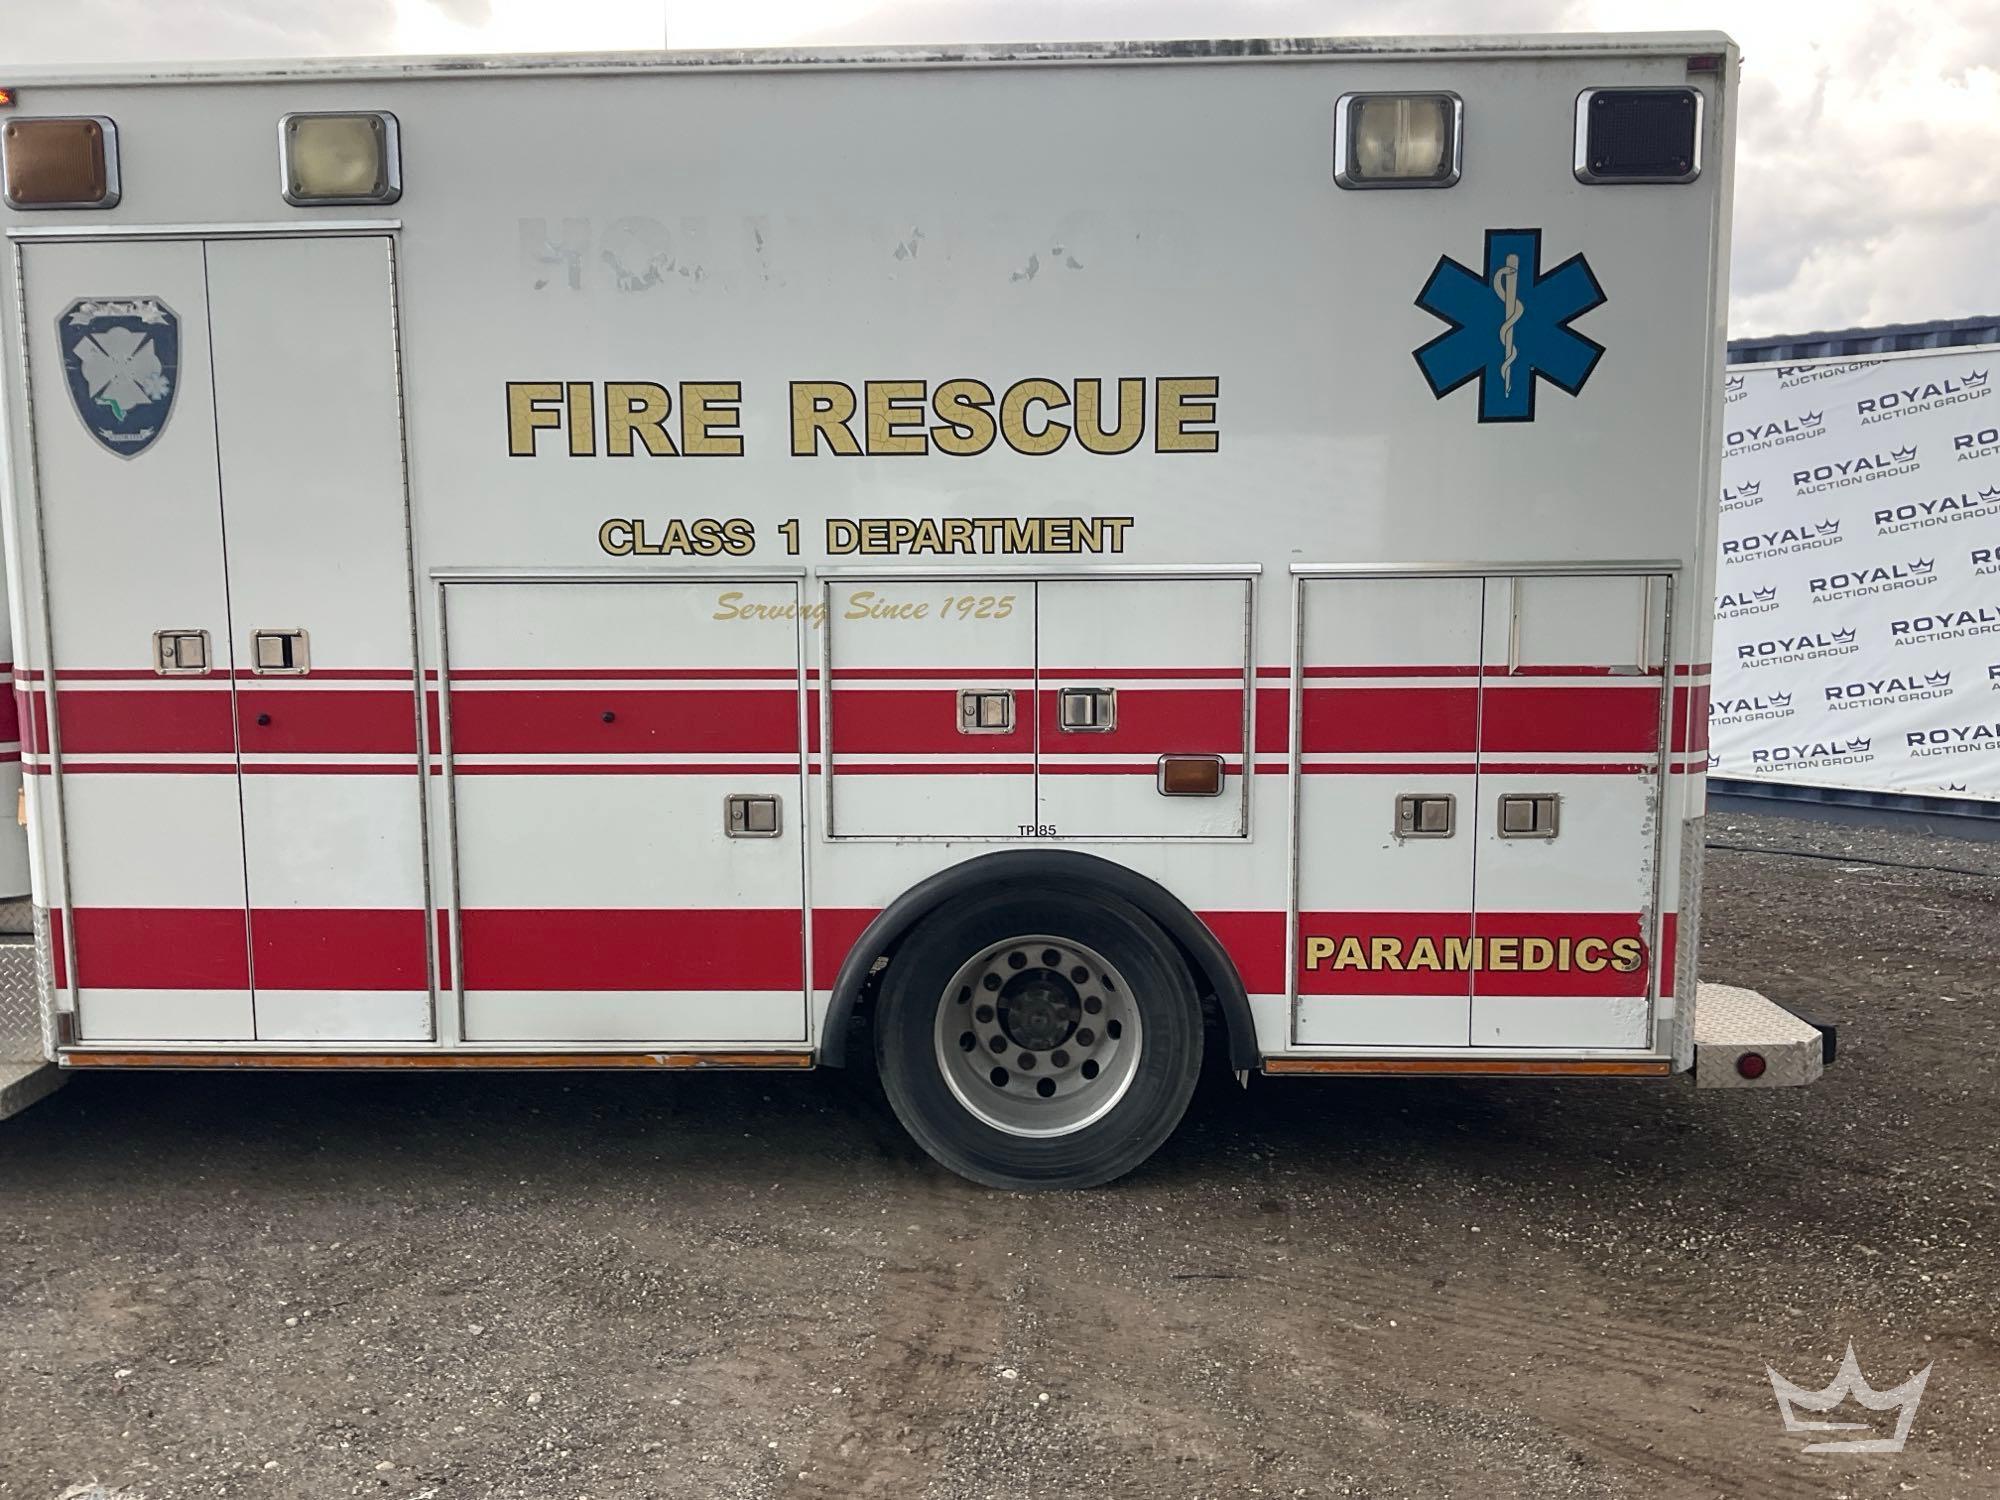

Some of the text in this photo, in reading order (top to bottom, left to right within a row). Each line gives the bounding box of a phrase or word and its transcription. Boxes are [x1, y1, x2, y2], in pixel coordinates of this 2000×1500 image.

[1780, 366, 1846, 389] AUCTION
[1849, 359, 1891, 372] GRO
[1857, 380, 1960, 415] ROYAL
[1861, 388, 1992, 426] AUCTION GROUP
[505, 376, 1220, 458] FIRE RESCUE
[1721, 428, 1826, 459] UCTION GROUP
[1726, 419, 1800, 446] OYAL
[1957, 445, 2000, 462] AUCT
[1793, 454, 1892, 486] ROYAL
[1796, 463, 1921, 496] AUCTION GROUP
[1874, 493, 1979, 525] ROYAL
[1878, 503, 2000, 536] AUCTION GROU
[599, 516, 1134, 556] CLASS 1 DEPARTMENT
[1722, 526, 1815, 555] ROYAL
[1725, 535, 1843, 565] AUCTION GROUP
[1809, 564, 1908, 593] ROYAL
[1812, 575, 1938, 604] AUCTION GROUP
[712, 591, 1016, 630] Serving Since 1925
[1730, 603, 1780, 618] GROUP
[1891, 608, 1995, 636] ROYAL
[1738, 633, 1831, 659] ROYAL
[1895, 623, 2000, 647] AUCTION GRO
[1741, 645, 1859, 669] AUCTION GROUP
[1825, 676, 1924, 701] ROYAL
[1828, 688, 1953, 711] AUCTION GROUP
[1709, 697, 1768, 716] YAL
[1709, 709, 1795, 726] TION GROUP
[1752, 741, 1846, 763] ROYAL
[1755, 754, 1874, 773] AUCTION GROUP
[1911, 743, 1981, 757] AUCTION
[1305, 936, 1643, 973] PARAMEDICS
